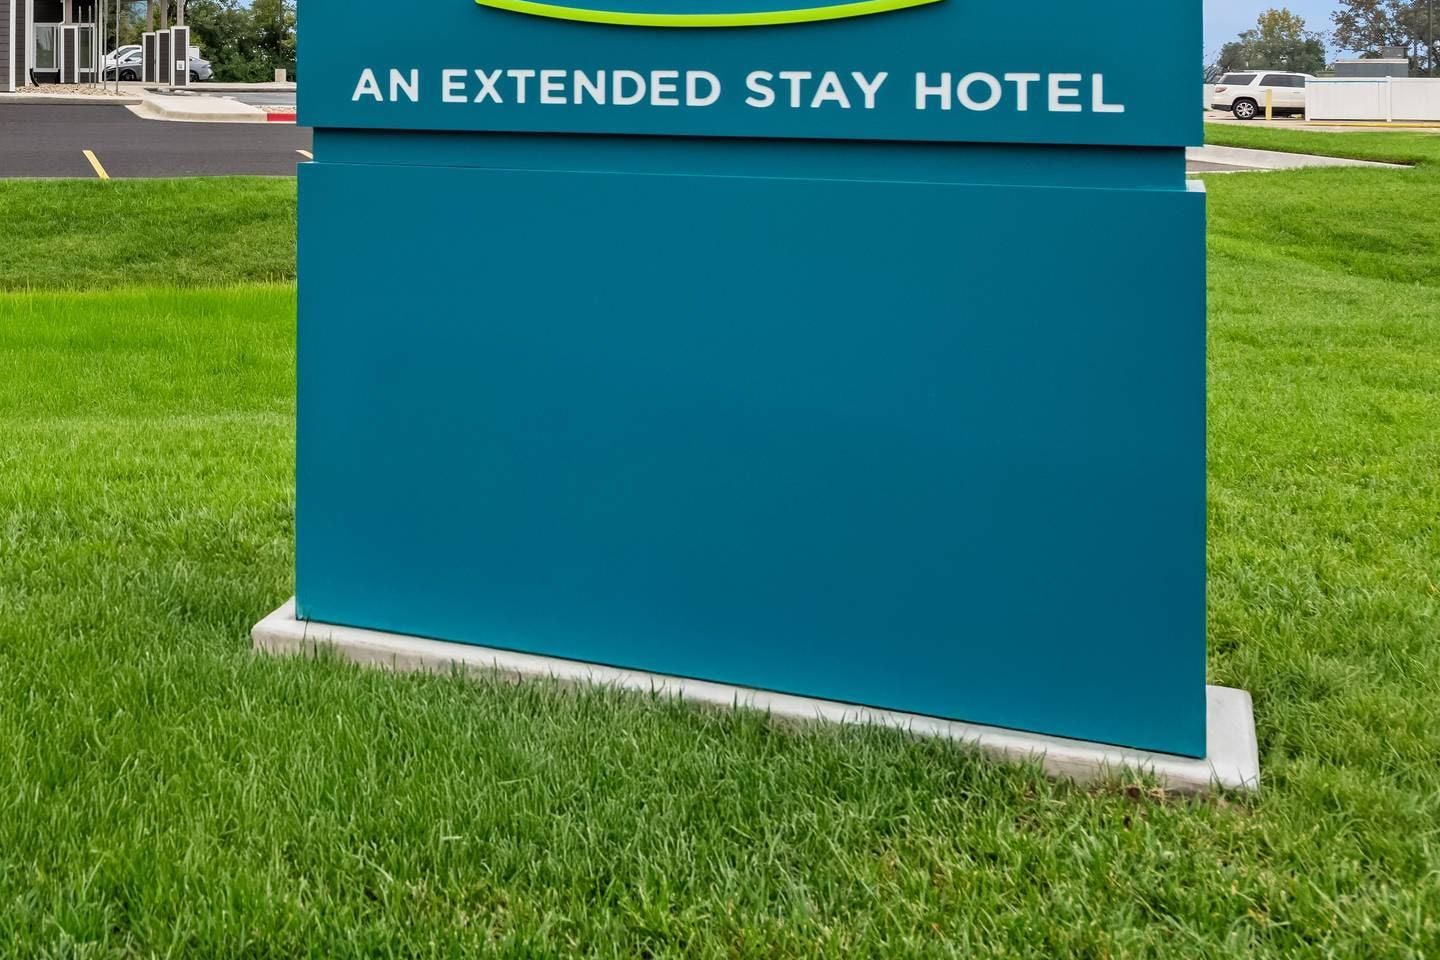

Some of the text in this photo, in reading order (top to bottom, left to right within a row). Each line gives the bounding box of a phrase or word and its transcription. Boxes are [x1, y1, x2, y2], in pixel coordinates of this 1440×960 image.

[352, 68, 1125, 113] AN EXTENDED STAY HOTEL
